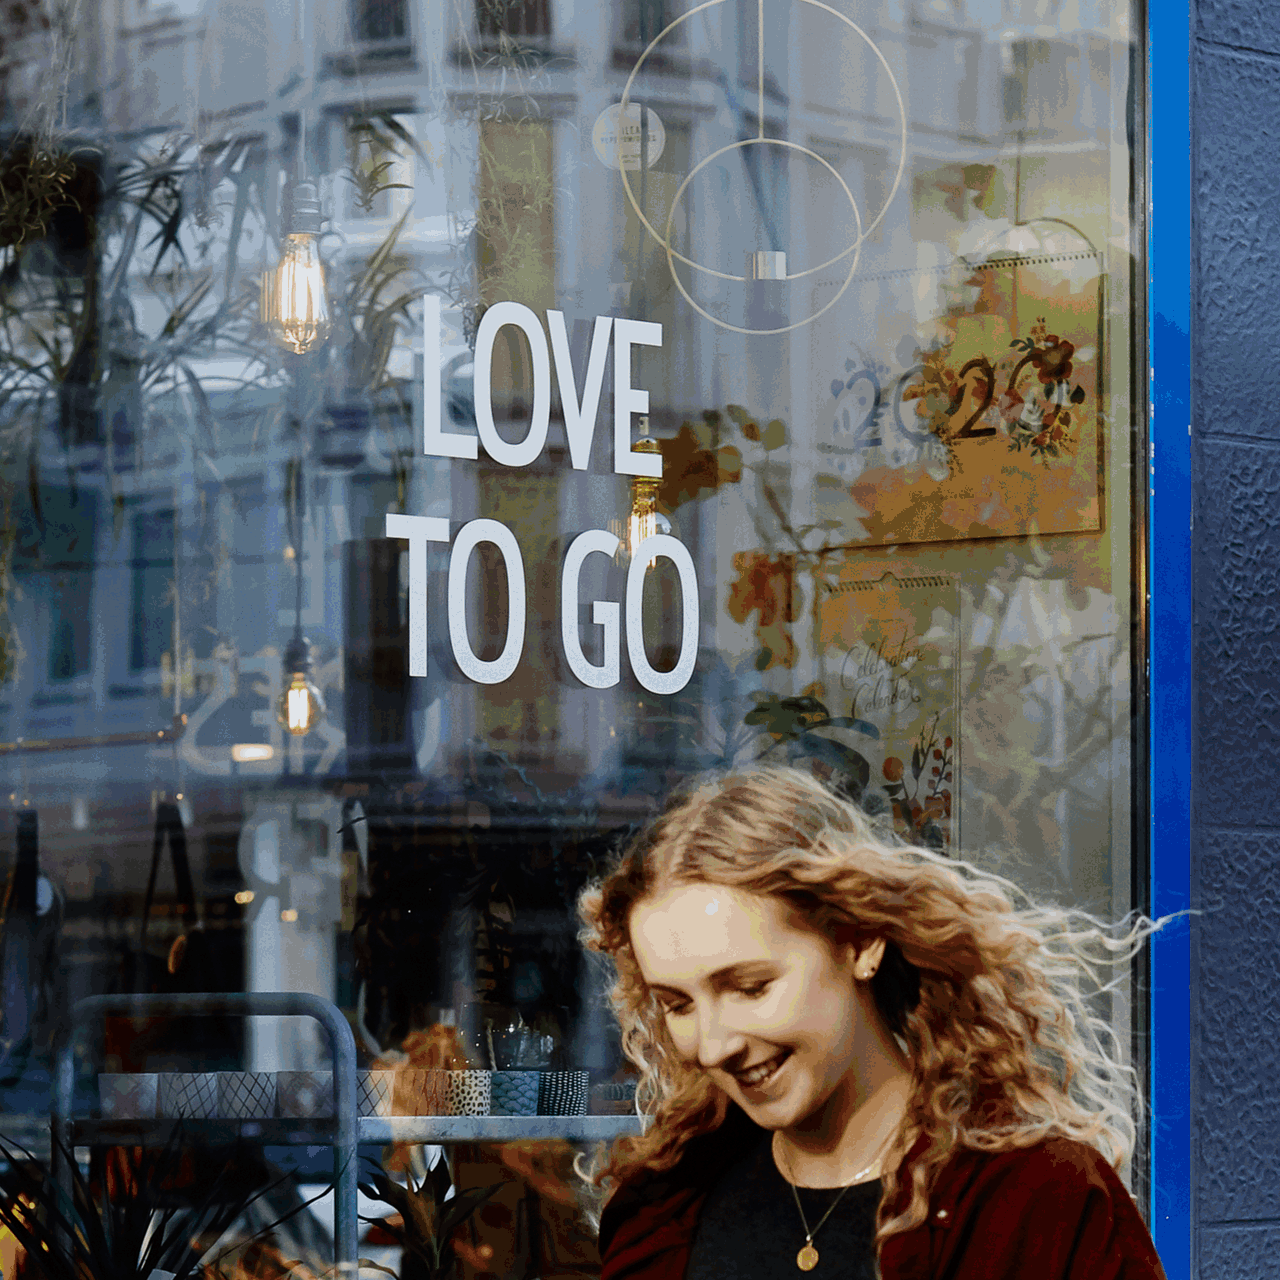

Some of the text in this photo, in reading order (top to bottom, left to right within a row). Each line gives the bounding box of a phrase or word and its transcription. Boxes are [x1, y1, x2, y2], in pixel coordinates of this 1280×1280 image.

[423, 293, 663, 478] LOVE
[385, 512, 700, 696] TO GO
